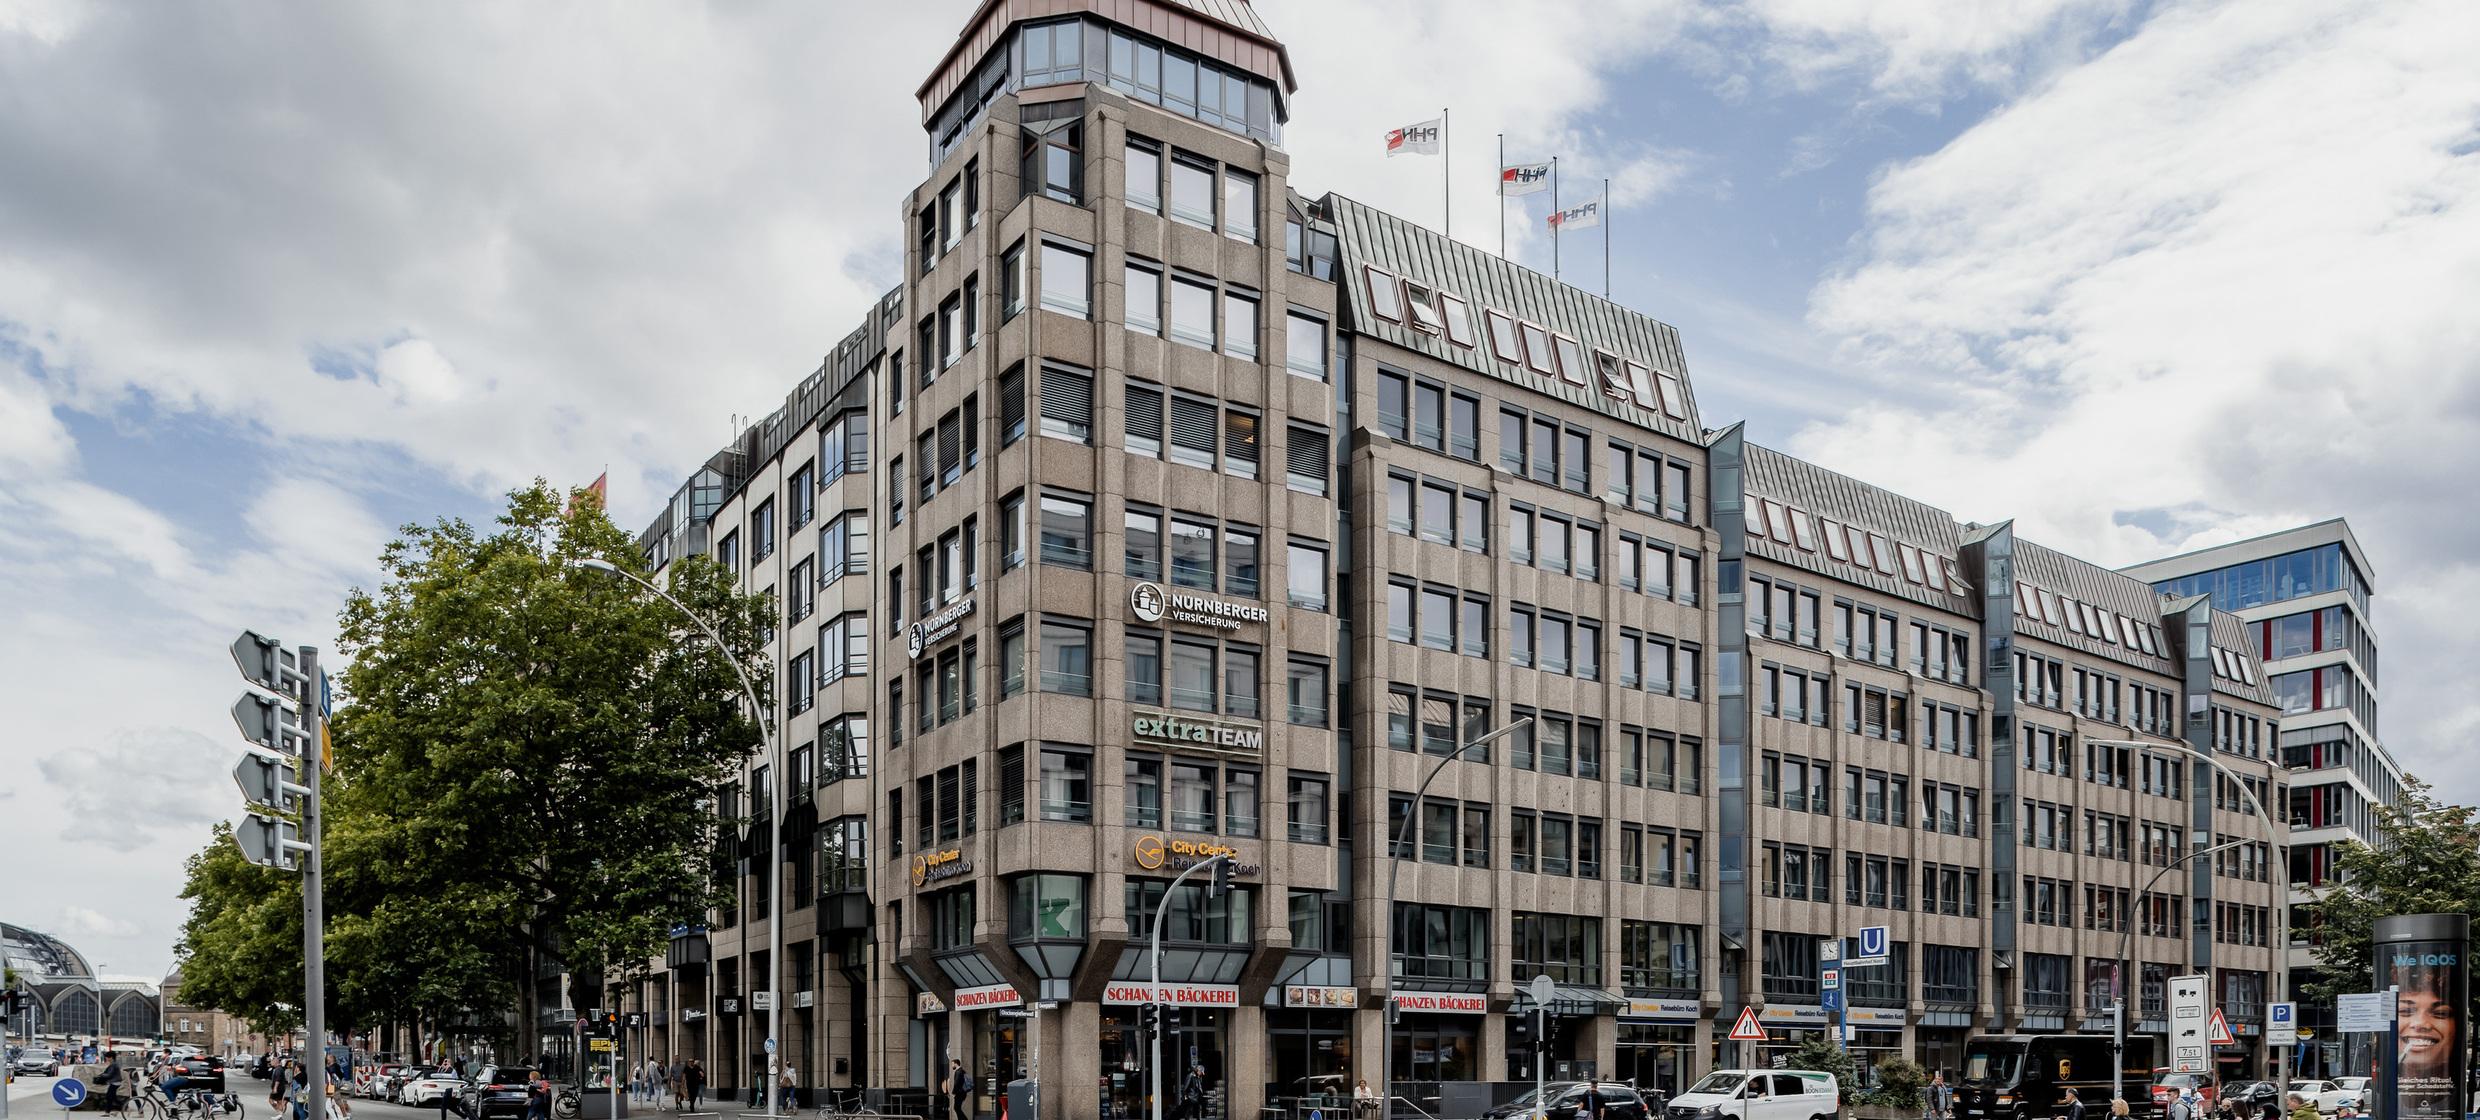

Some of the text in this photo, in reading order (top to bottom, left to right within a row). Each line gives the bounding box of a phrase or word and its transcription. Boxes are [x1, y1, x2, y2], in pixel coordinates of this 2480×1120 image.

[1172, 594, 1268, 622] NÜRNBERGER
[1173, 610, 1241, 630] VERSICHERUNG
[1134, 717, 1262, 749] extra TEAM
[1171, 840, 1197, 856] City
[1233, 861, 1261, 876] Koch
[1863, 929, 1881, 954] U
[2392, 954, 2457, 967] We IQOS
[956, 991, 987, 1007] SCHANZEN
[1107, 986, 1236, 1004] SCHANEN BÄCKEREI
[1439, 995, 1485, 1011] BÄCKEREI
[1685, 1005, 1698, 1013] Koch
[2276, 1007, 2287, 1020] P
